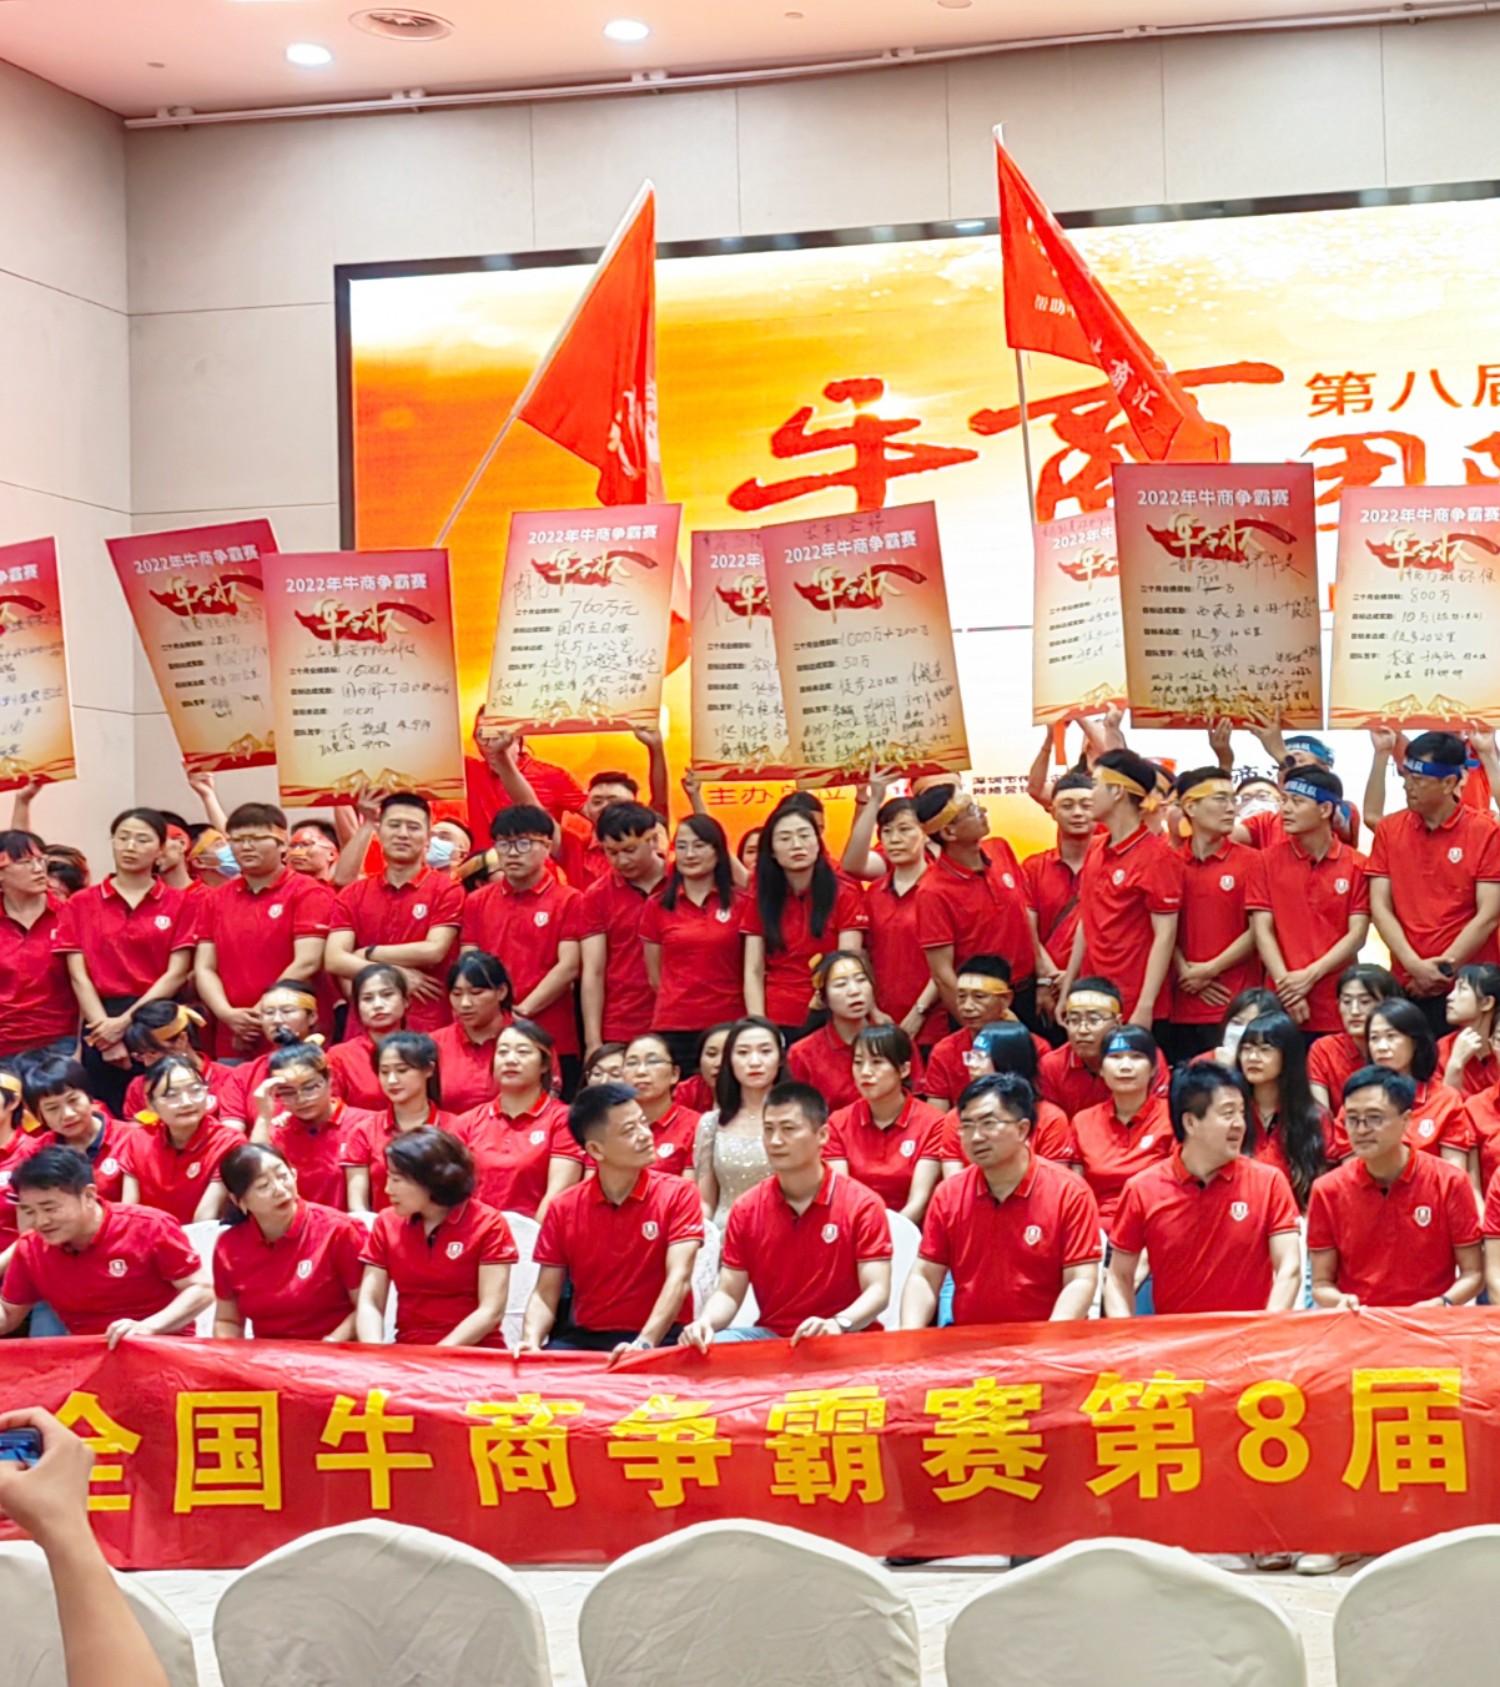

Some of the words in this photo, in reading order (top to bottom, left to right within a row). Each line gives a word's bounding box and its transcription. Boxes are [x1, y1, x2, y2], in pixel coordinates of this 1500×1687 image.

[1138, 489, 1289, 507] 2022年牛商争霸赛
[1360, 507, 1500, 523] 2022年牛商争霸赛
[528, 525, 658, 545] 2022年牛商争霸赛
[784, 530, 918, 564] 2022年牛商争霸赛
[134, 544, 259, 574] 2022年牛商争霸赛
[286, 573, 428, 593] 2022年牛商争霸赛
[707, 784, 847, 806] 主办位
